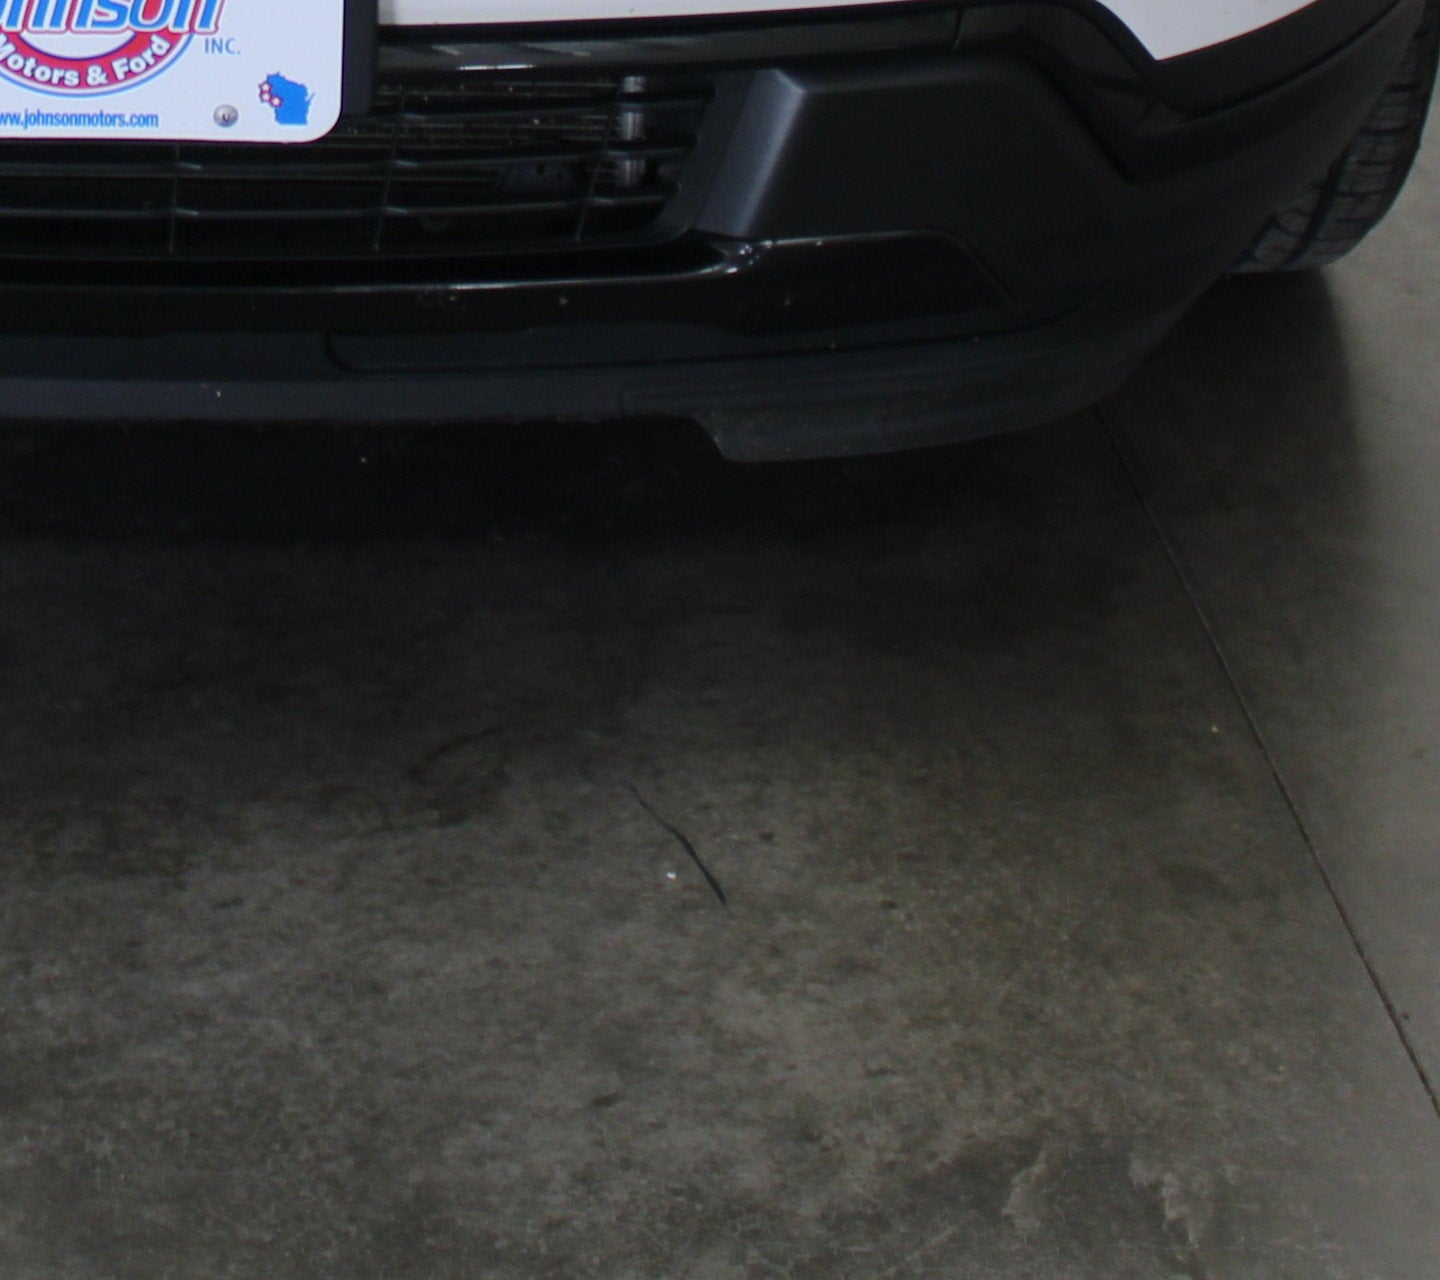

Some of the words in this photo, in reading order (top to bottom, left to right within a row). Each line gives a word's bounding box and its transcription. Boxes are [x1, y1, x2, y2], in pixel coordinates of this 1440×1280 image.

[86, 65, 109, 86] &
[110, 35, 171, 81] Ford
[204, 37, 242, 56] INC.
